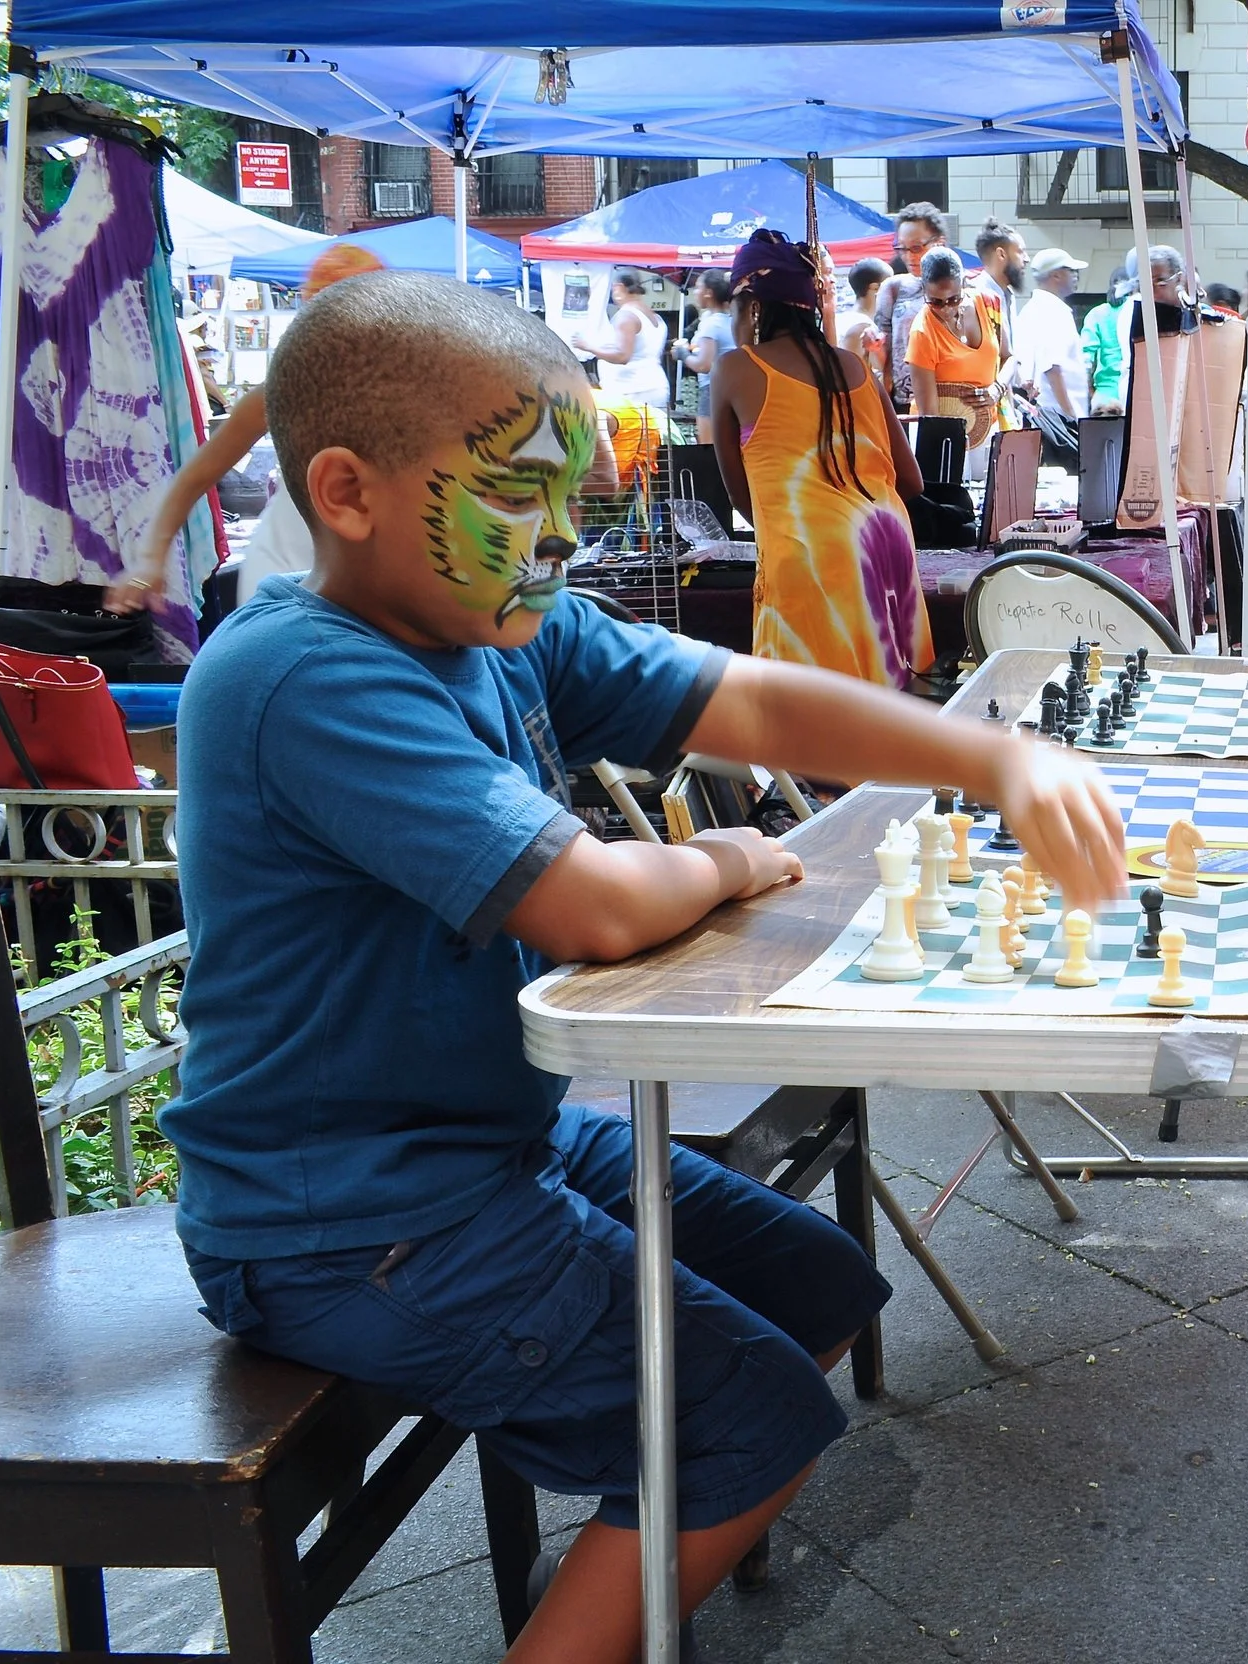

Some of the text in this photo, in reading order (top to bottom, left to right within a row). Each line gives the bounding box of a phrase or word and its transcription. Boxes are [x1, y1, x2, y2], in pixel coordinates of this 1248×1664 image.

[241, 147, 287, 157] NO STANDING
[249, 157, 280, 166] ANYTIME
[1052, 601, 1122, 645] Rolle
